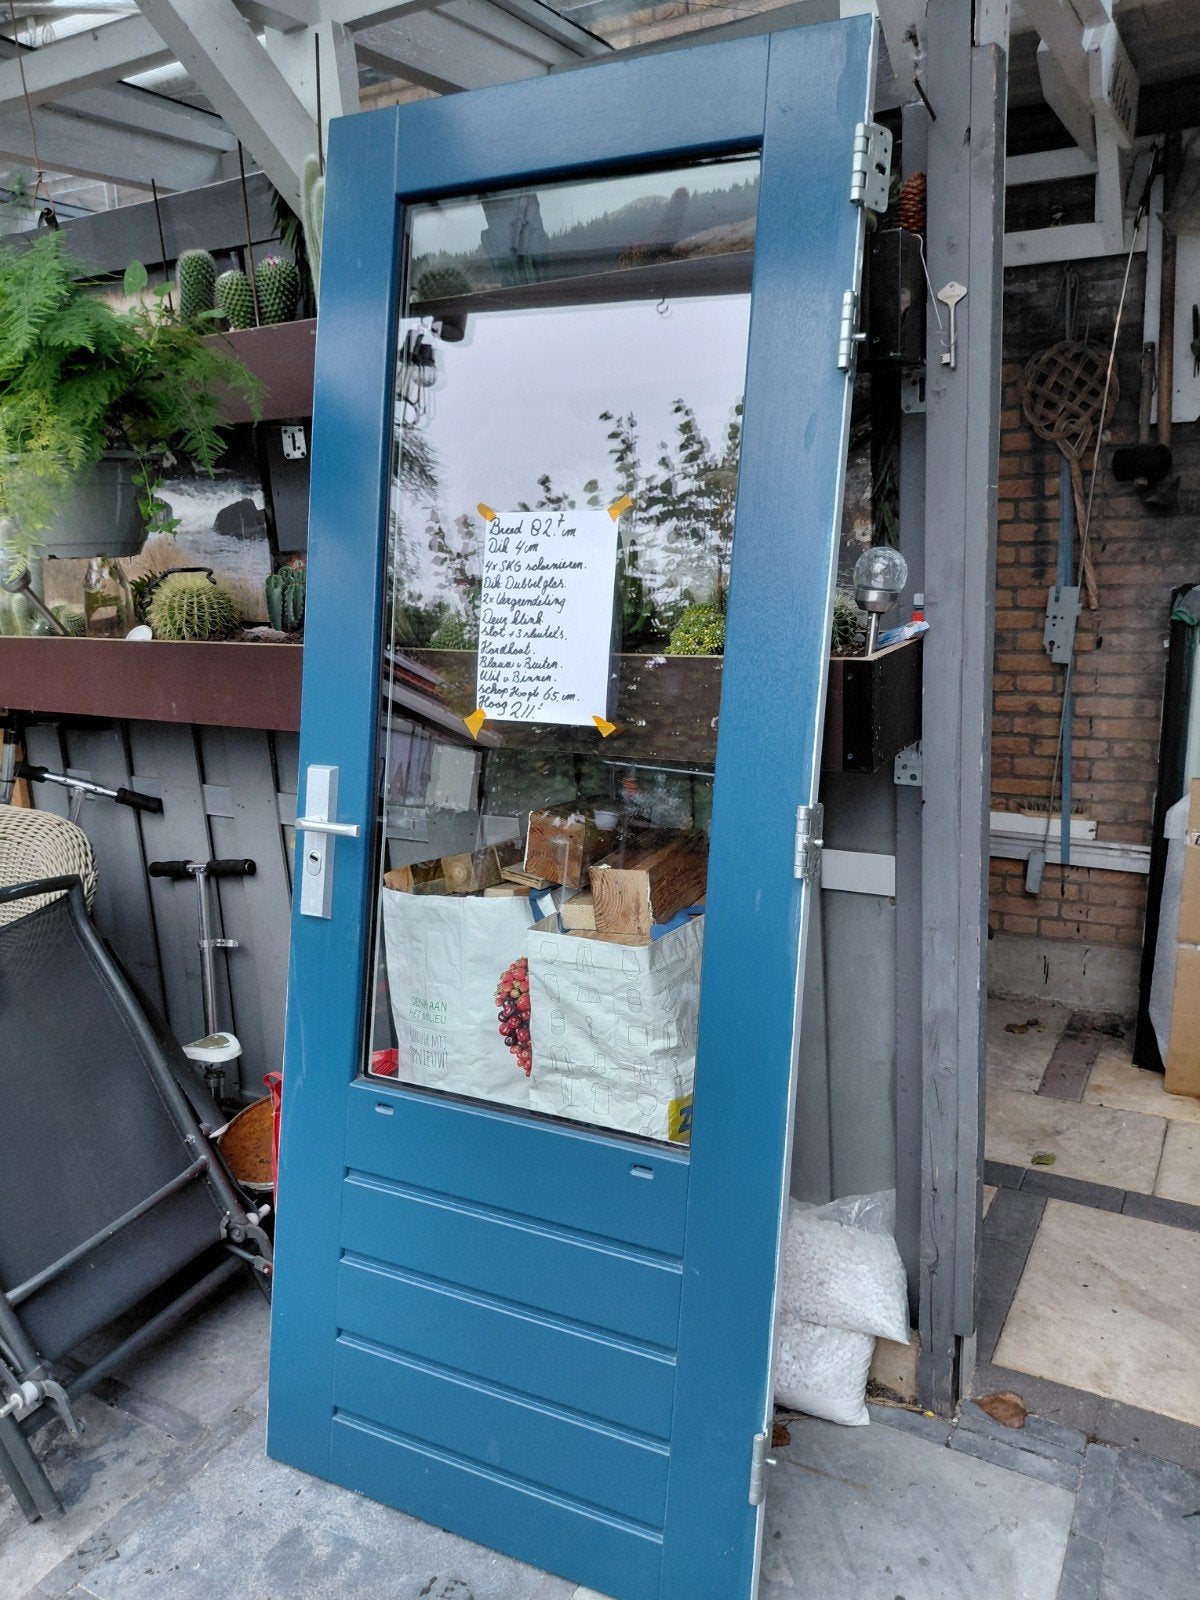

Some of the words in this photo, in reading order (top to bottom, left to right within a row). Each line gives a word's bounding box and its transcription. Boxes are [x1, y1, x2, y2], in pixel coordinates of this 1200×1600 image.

[489, 516, 523, 535] Breed
[488, 537, 509, 553] Dik
[499, 559, 522, 572] SKG
[482, 592, 494, 605] 2x
[478, 694, 508, 716] Hoog
[429, 1001, 447, 1012] AAN
